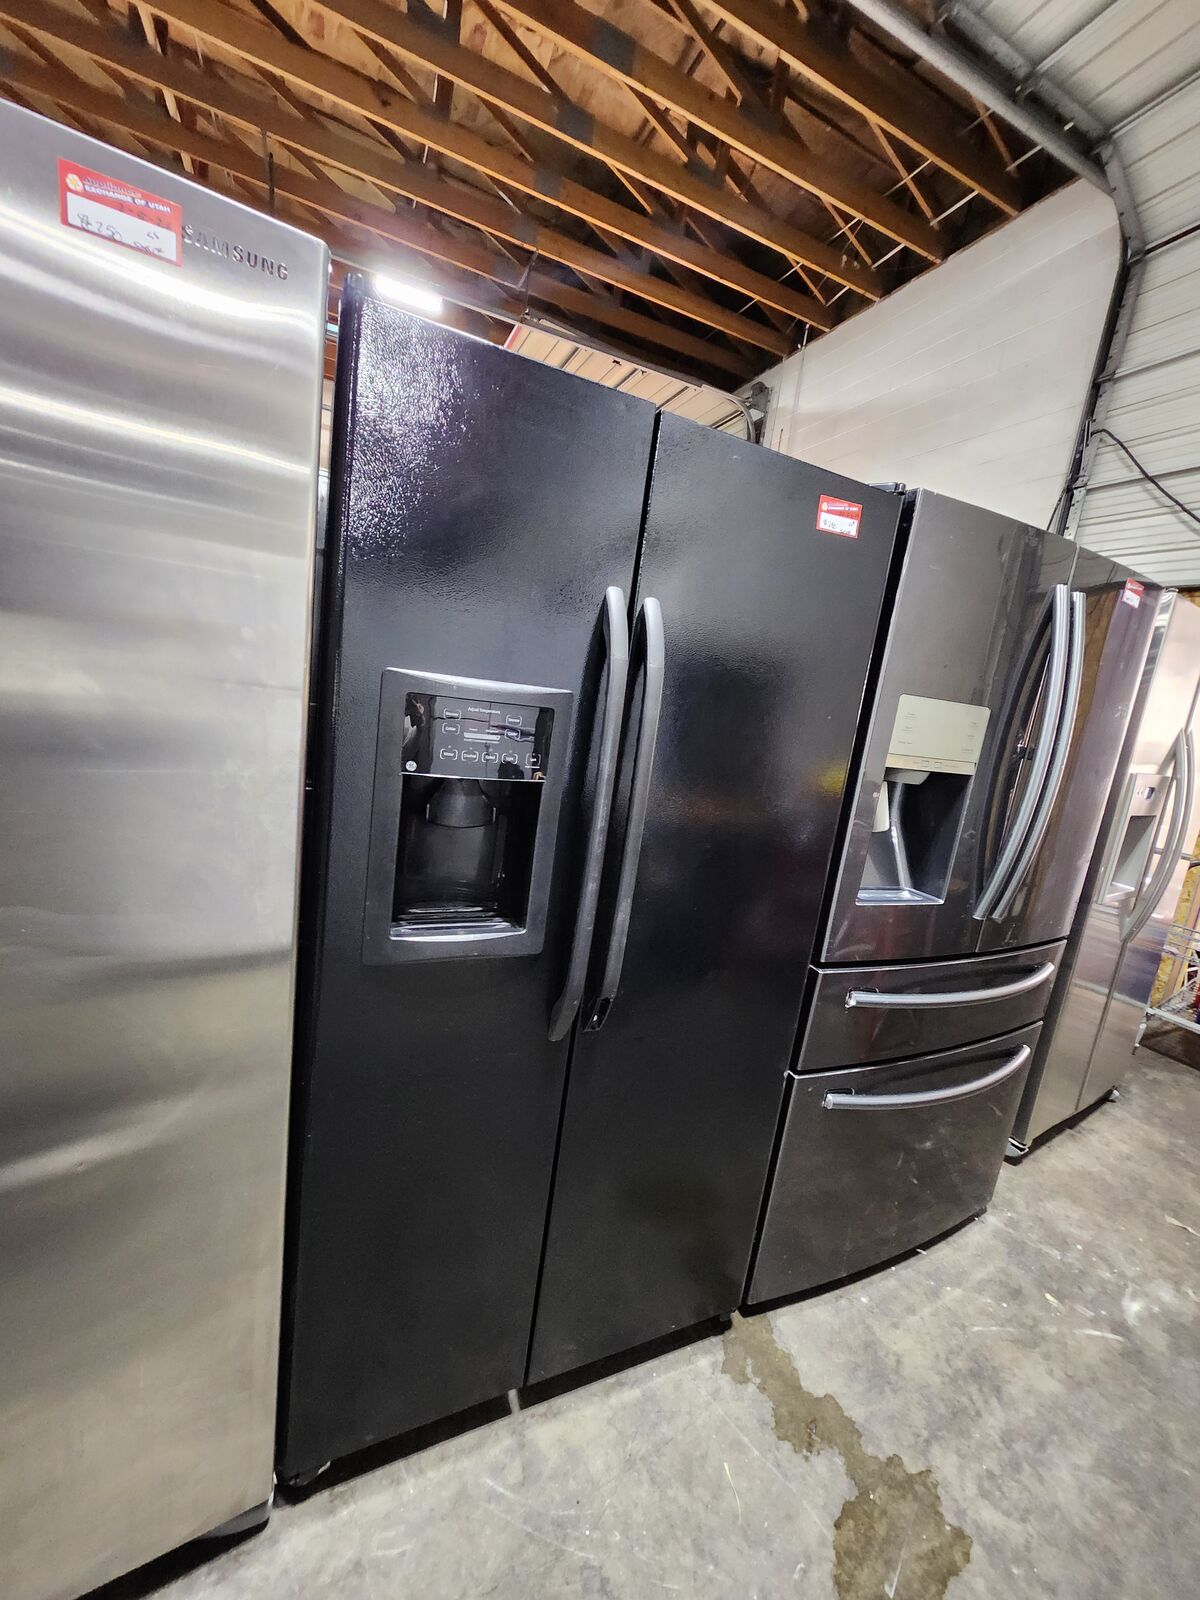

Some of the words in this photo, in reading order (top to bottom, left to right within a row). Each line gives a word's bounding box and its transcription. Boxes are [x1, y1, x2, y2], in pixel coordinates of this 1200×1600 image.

[84, 184, 133, 203] EXCHANGE
[135, 197, 146, 206] OF
[148, 202, 171, 213] UTAH
[183, 224, 289, 280] SAMSUNG
